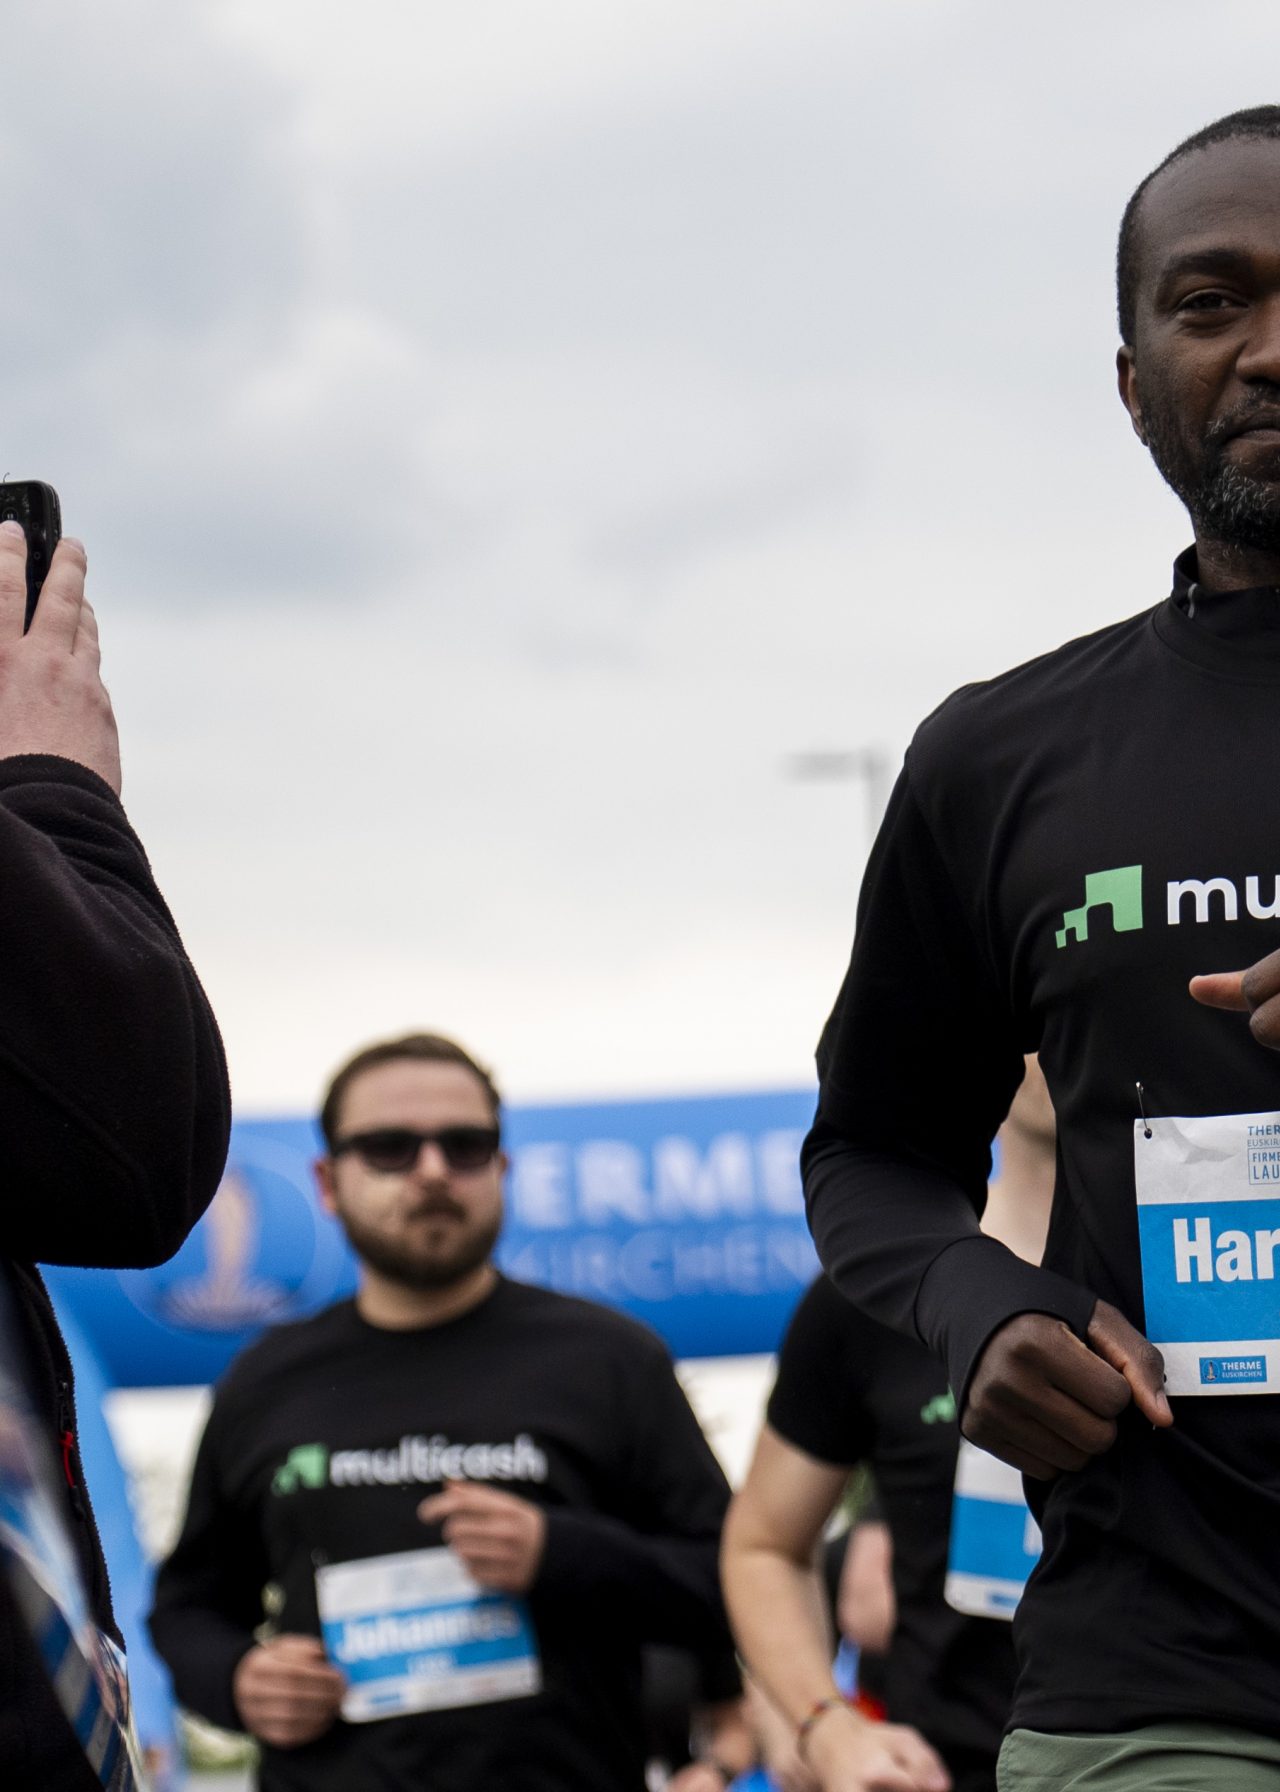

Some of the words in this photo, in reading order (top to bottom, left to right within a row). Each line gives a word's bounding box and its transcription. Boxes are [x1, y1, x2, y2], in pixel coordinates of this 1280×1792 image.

[512, 1131, 808, 1227] ERME
[1221, 1361, 1262, 1371] THERME
[1221, 1370, 1262, 1378] EUSKIRCHEN
[330, 1433, 548, 1487] multicash
